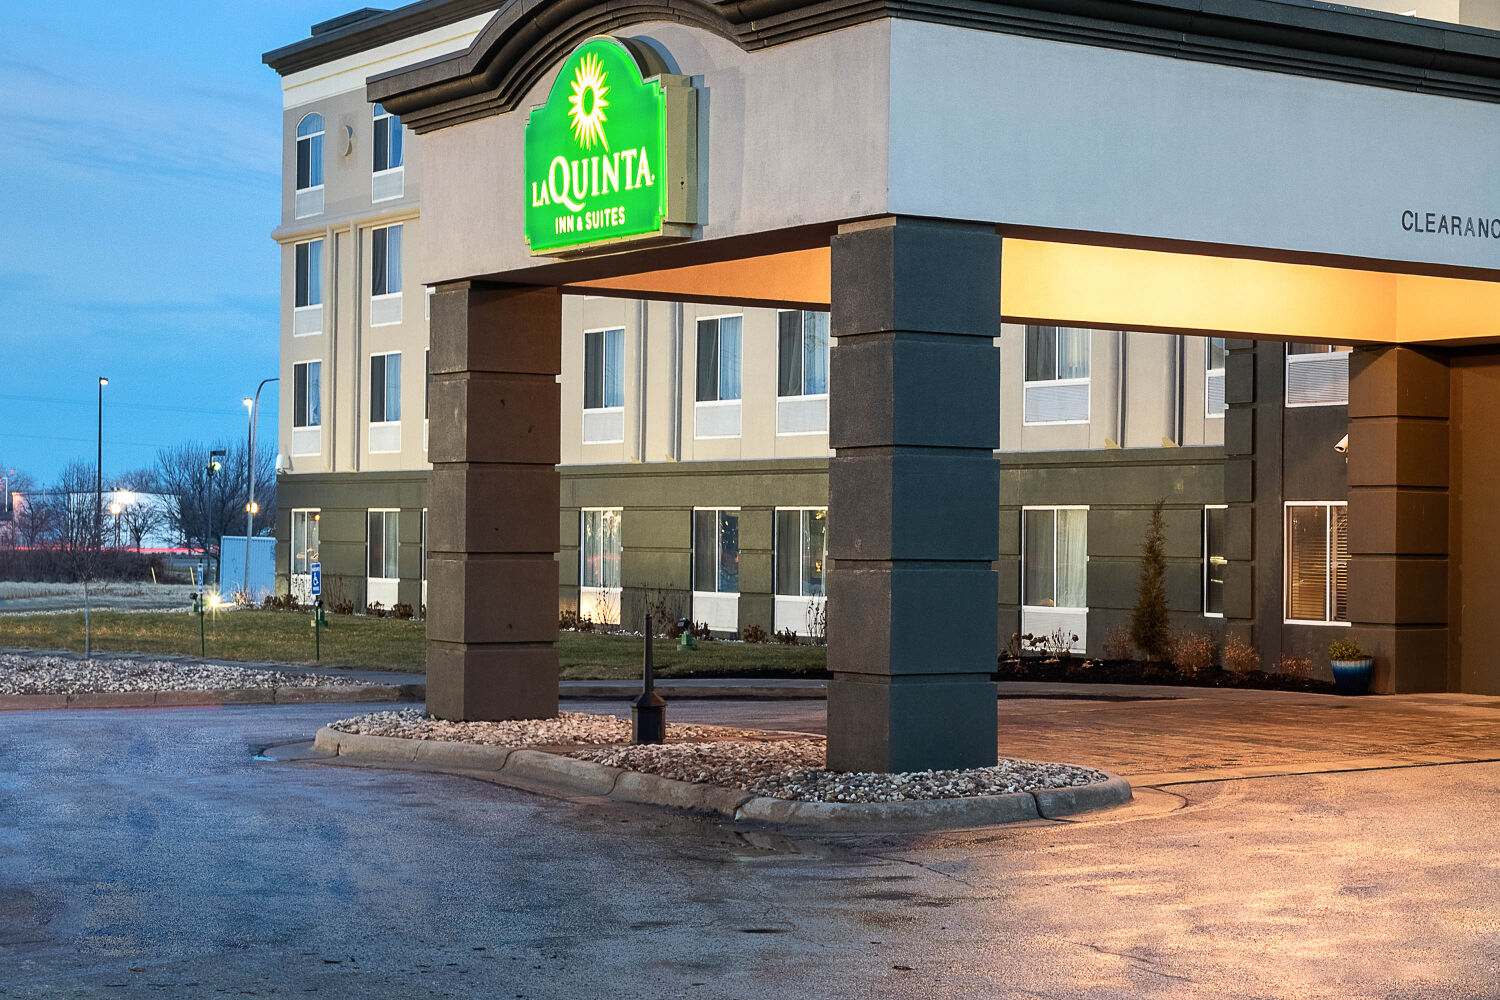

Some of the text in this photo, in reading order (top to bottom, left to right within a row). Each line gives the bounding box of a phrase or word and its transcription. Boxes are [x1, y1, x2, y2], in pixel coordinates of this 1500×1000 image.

[532, 146, 654, 213] LA QUINTA
[555, 206, 626, 235] INN & SUITES
